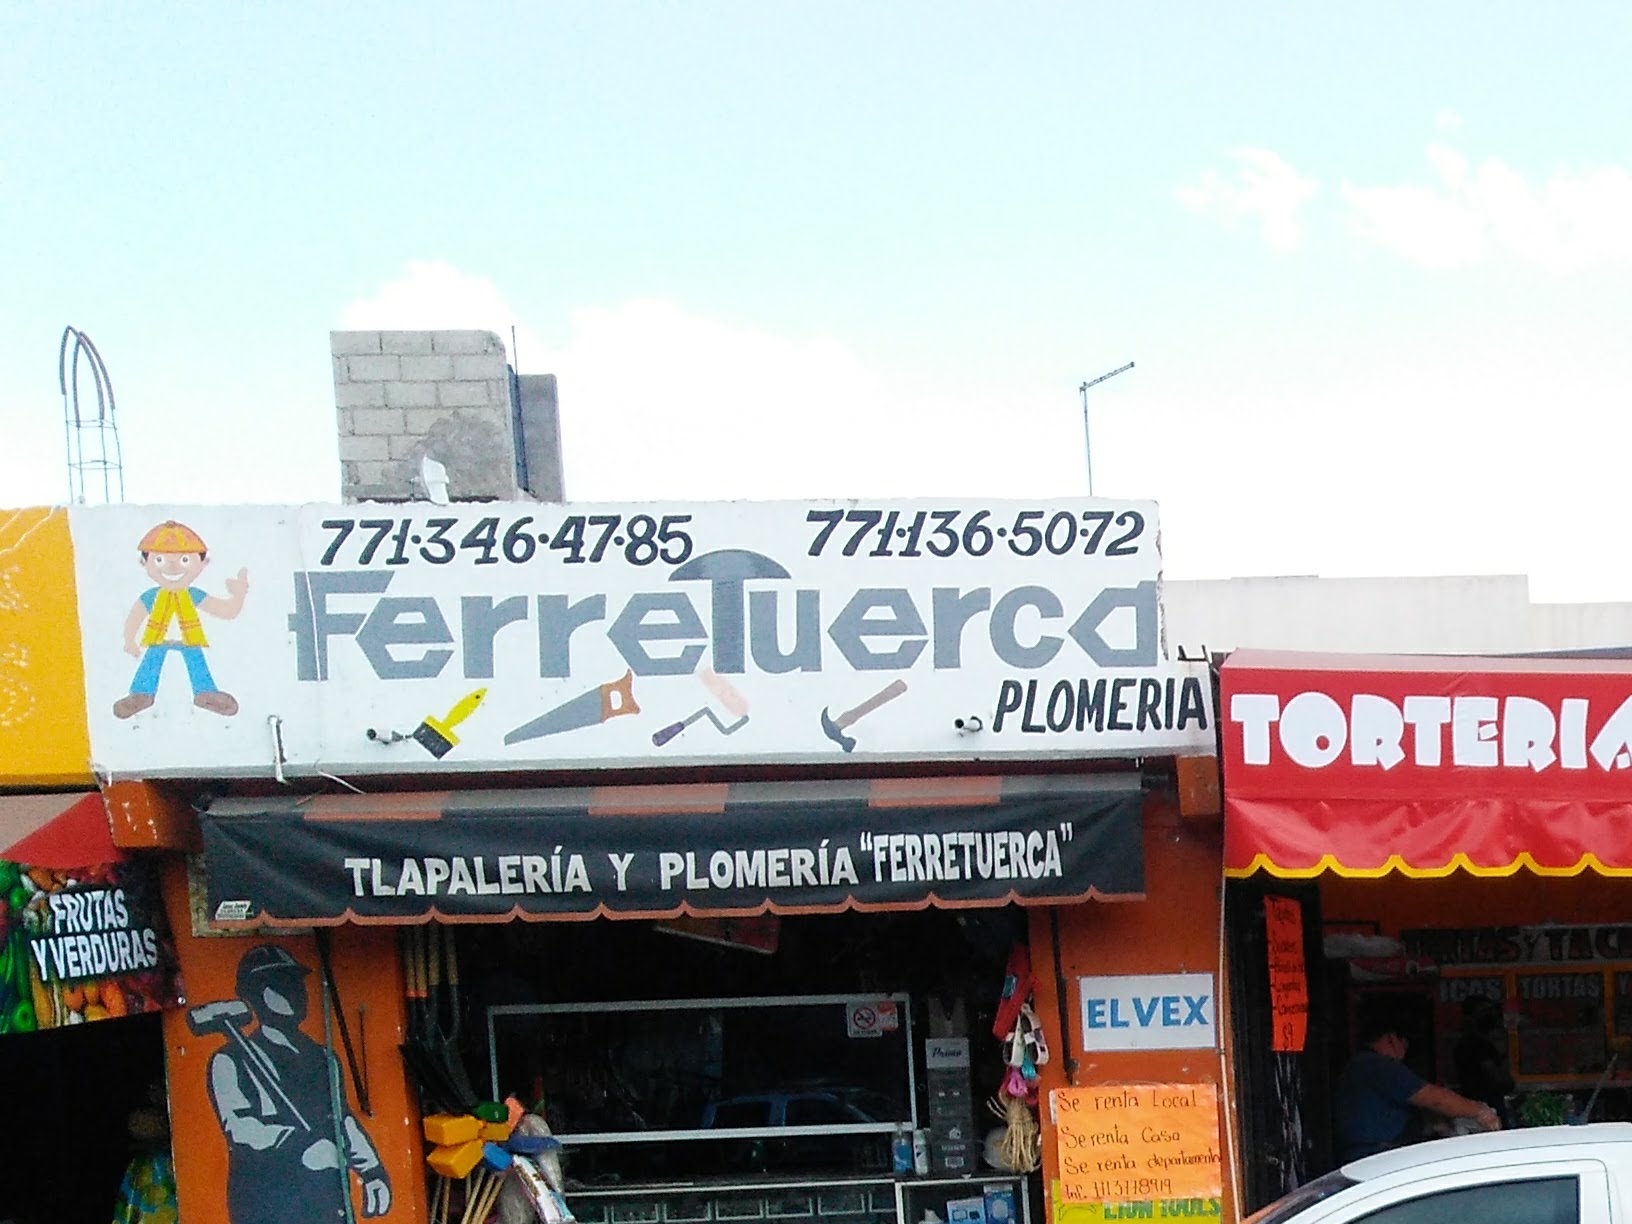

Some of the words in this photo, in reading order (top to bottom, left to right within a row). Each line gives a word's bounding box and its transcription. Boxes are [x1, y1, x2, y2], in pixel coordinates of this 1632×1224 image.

[993, 676, 1209, 734] PLOMERIA
[345, 845, 592, 897] TLAPALERÍA
[608, 852, 634, 891] Y
[659, 839, 859, 891] PLOMERÍA
[49, 889, 128, 935] FRUTAS
[30, 938, 48, 981] Y
[48, 928, 158, 980] VERDURAS
[1087, 995, 1209, 1029] ELVEX
[1057, 1091, 1080, 1113] Se
[1094, 1090, 1140, 1112] renta
[1152, 1089, 1197, 1110] Local
[1060, 1125, 1086, 1149] Se
[1090, 1123, 1130, 1147] renta
[1141, 1126, 1181, 1144] Casa
[1064, 1156, 1088, 1175] Se
[1097, 1153, 1136, 1172] renta
